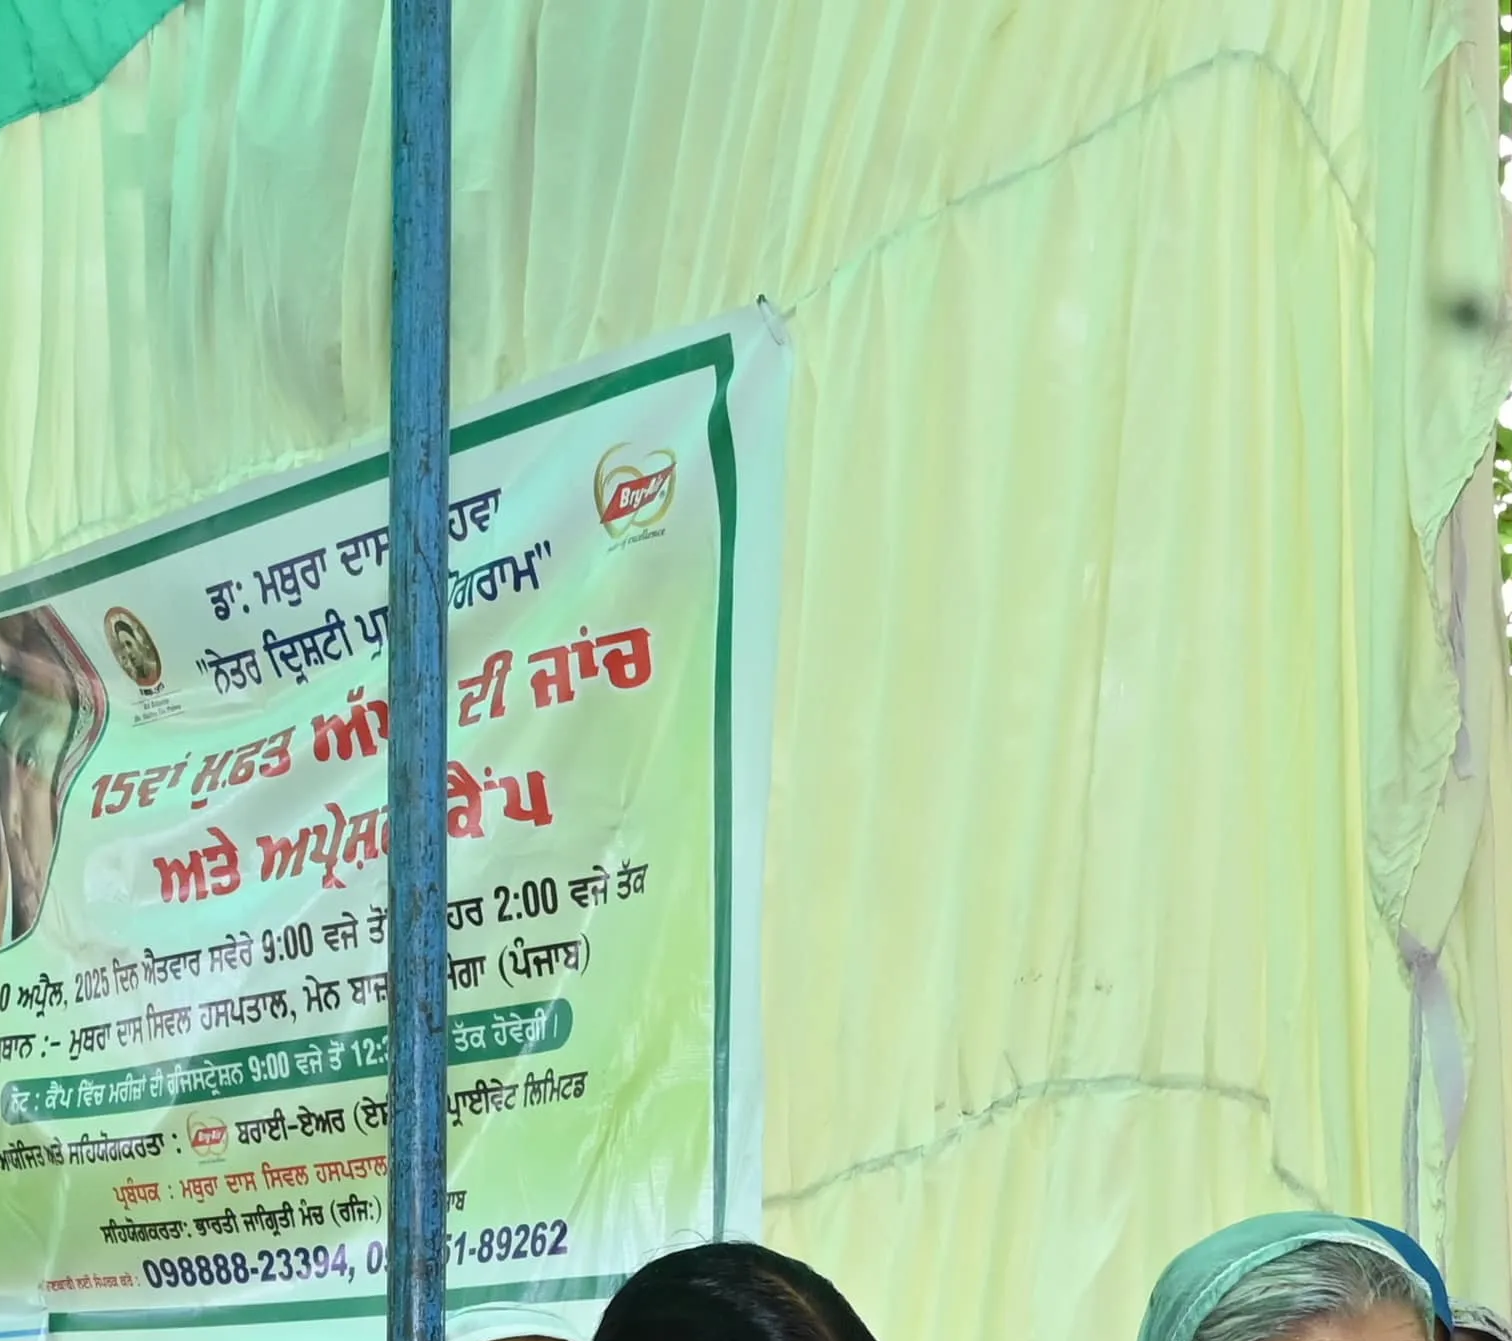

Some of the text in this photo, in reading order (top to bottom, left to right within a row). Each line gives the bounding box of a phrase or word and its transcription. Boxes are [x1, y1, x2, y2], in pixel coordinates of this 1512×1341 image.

[458, 650, 513, 727] ਦੀ
[153, 826, 241, 903] ਅਤੇ
[75, 966, 110, 1003] 2025
[262, 922, 314, 964] 9:00
[322, 911, 359, 952] ਵਜੇ
[494, 877, 559, 922] 2:00
[567, 865, 609, 906] ਵਜੇ
[616, 858, 649, 900] ਤੱਕ
[117, 1014, 143, 1047] ਦਾਸ
[247, 1051, 290, 1082] 9:00
[295, 1044, 323, 1075] ਵਜੇ
[142, 1243, 356, 1289] 098888-23394,
